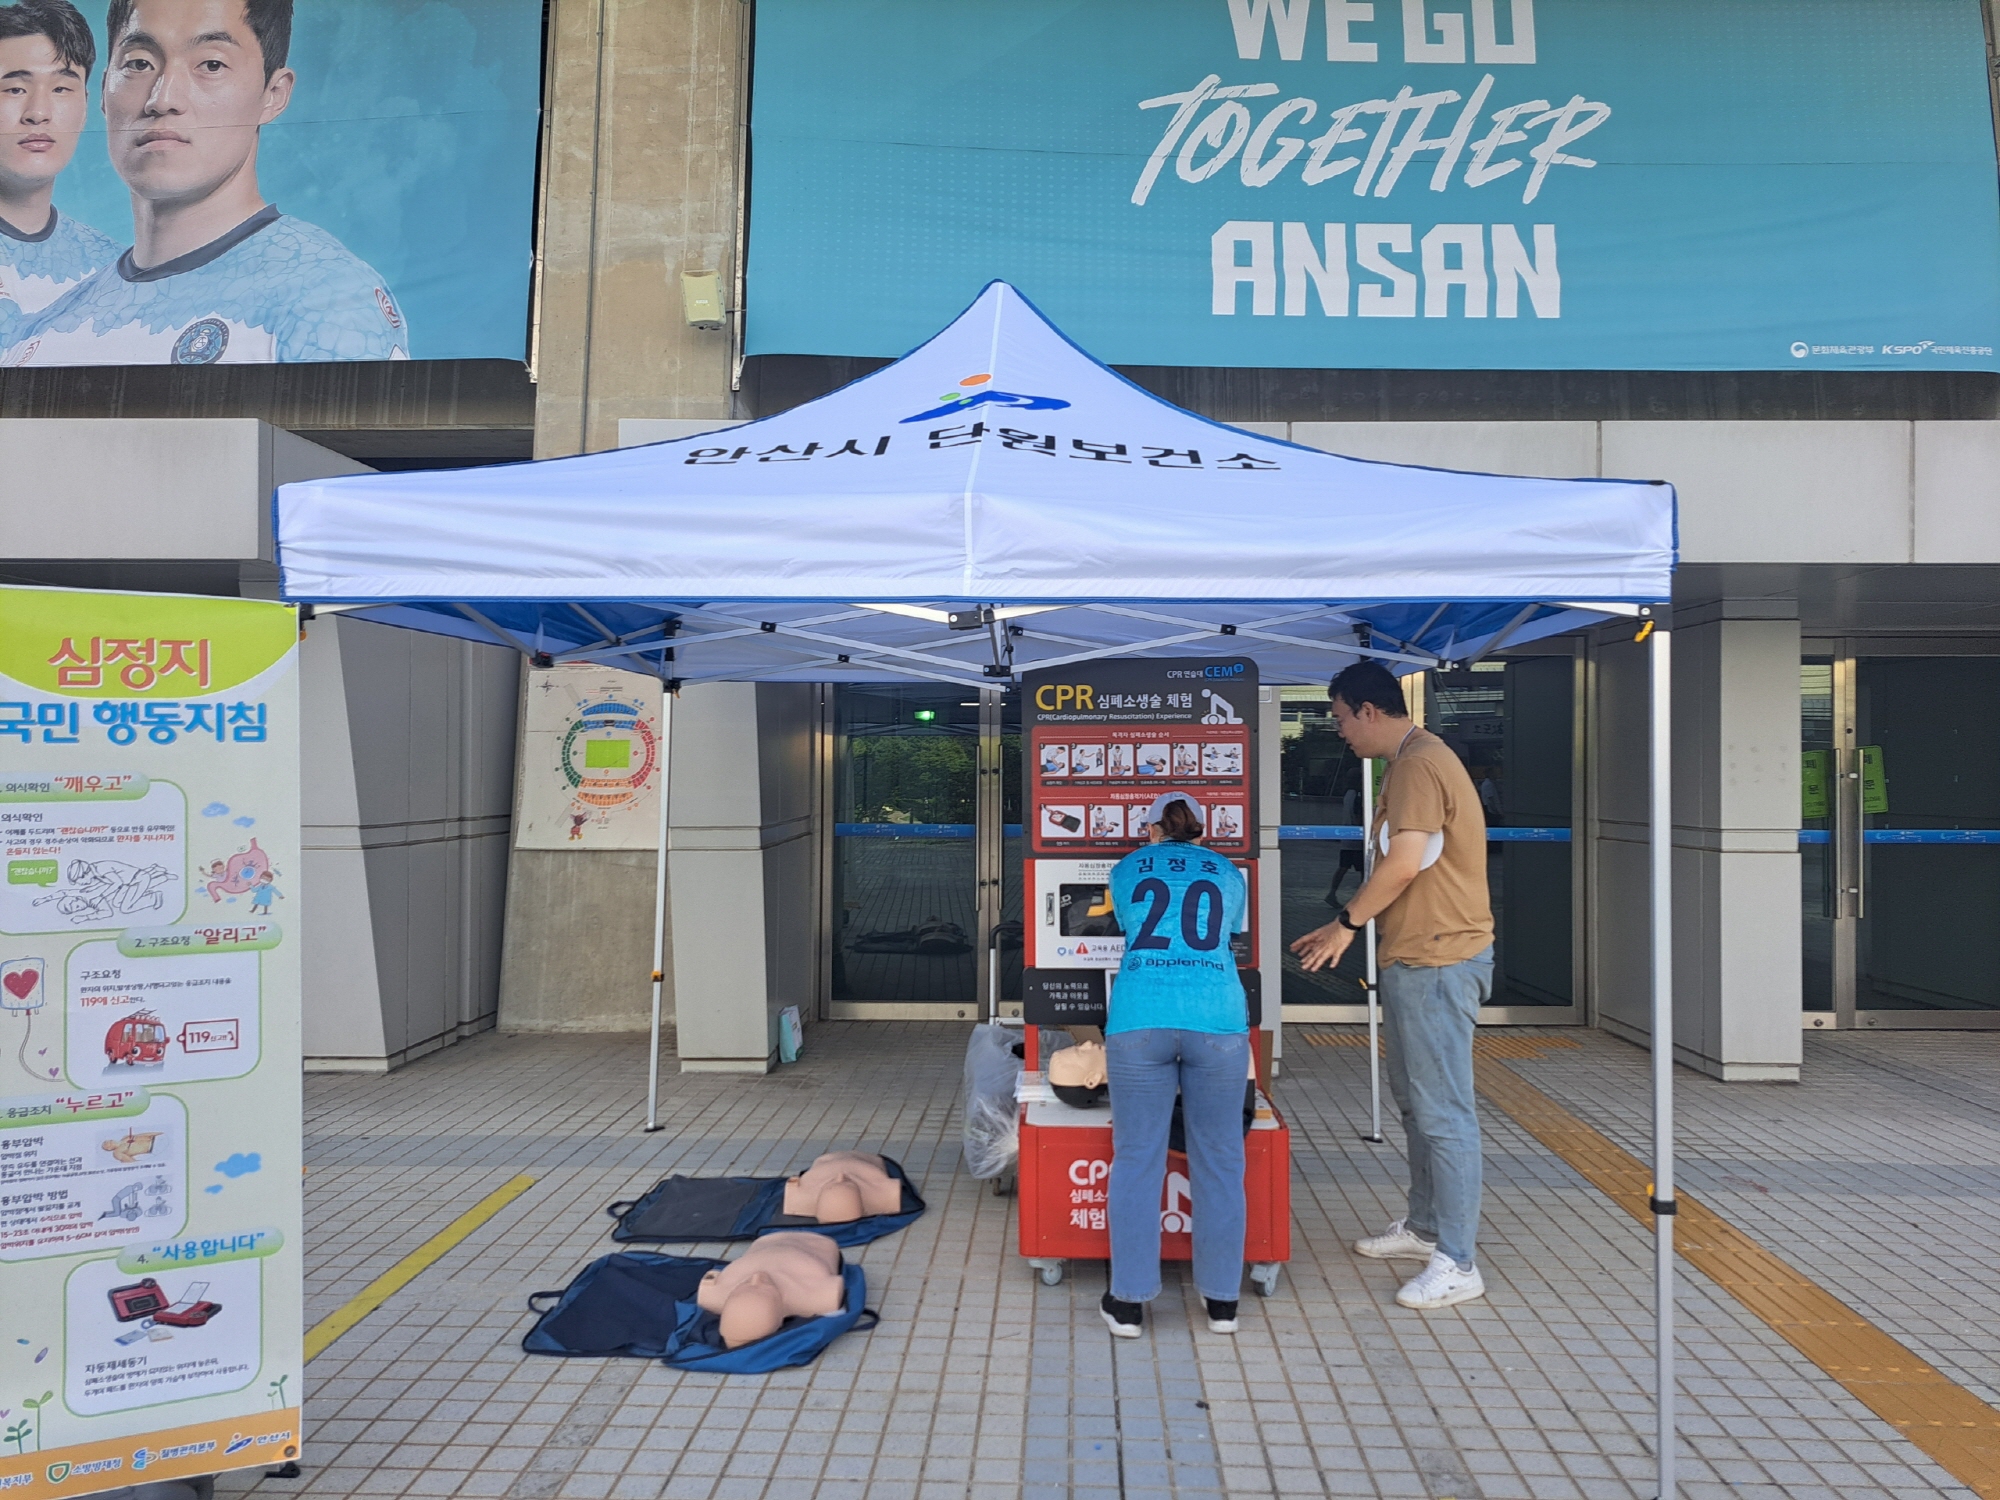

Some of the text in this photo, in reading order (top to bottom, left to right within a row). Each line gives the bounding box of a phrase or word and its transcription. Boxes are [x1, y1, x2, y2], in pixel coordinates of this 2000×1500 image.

[1227, 0, 1378, 62] WE
[1131, 73, 1611, 205] TOGETHER
[1211, 220, 1561, 318] ANSAN
[1882, 345, 1922, 355] KSPO
[684, 424, 1281, 471] 안산시 단원보건소
[47, 636, 211, 691] 심정지
[1166, 670, 1182, 679] CPR
[1035, 684, 1193, 711] CPR 심폐소생술 체험
[0, 701, 267, 746] 국민 행동지침
[1037, 713, 1192, 722] CPR(Cardiopulmonary Resuscitation) Experience
[5, 783, 50, 793] 의식확인
[1, 813, 43, 822] 의식확인
[1129, 877, 1223, 951] 20
[135, 938, 146, 948] 2.
[149, 936, 190, 946] 구조요청
[81, 970, 121, 979] 구조요청
[81, 997, 108, 1007] 119에
[7, 1105, 52, 1118] 응급조치
[1, 1136, 44, 1149] 흉부압박
[1069, 1159, 1113, 1185] CP
[1, 1189, 68, 1206] 흉부압박 방법
[1069, 1189, 1108, 1203] 심폐소
[1070, 1208, 1106, 1229] 체험
[137, 1254, 149, 1264] 4.
[85, 1356, 147, 1374] 자동제세동기
[256, 1430, 291, 1445] 안산시
[161, 1440, 216, 1458] 질병관리본부
[71, 1457, 122, 1475] 소방방재청
[0, 1473, 33, 1489] 복지부
